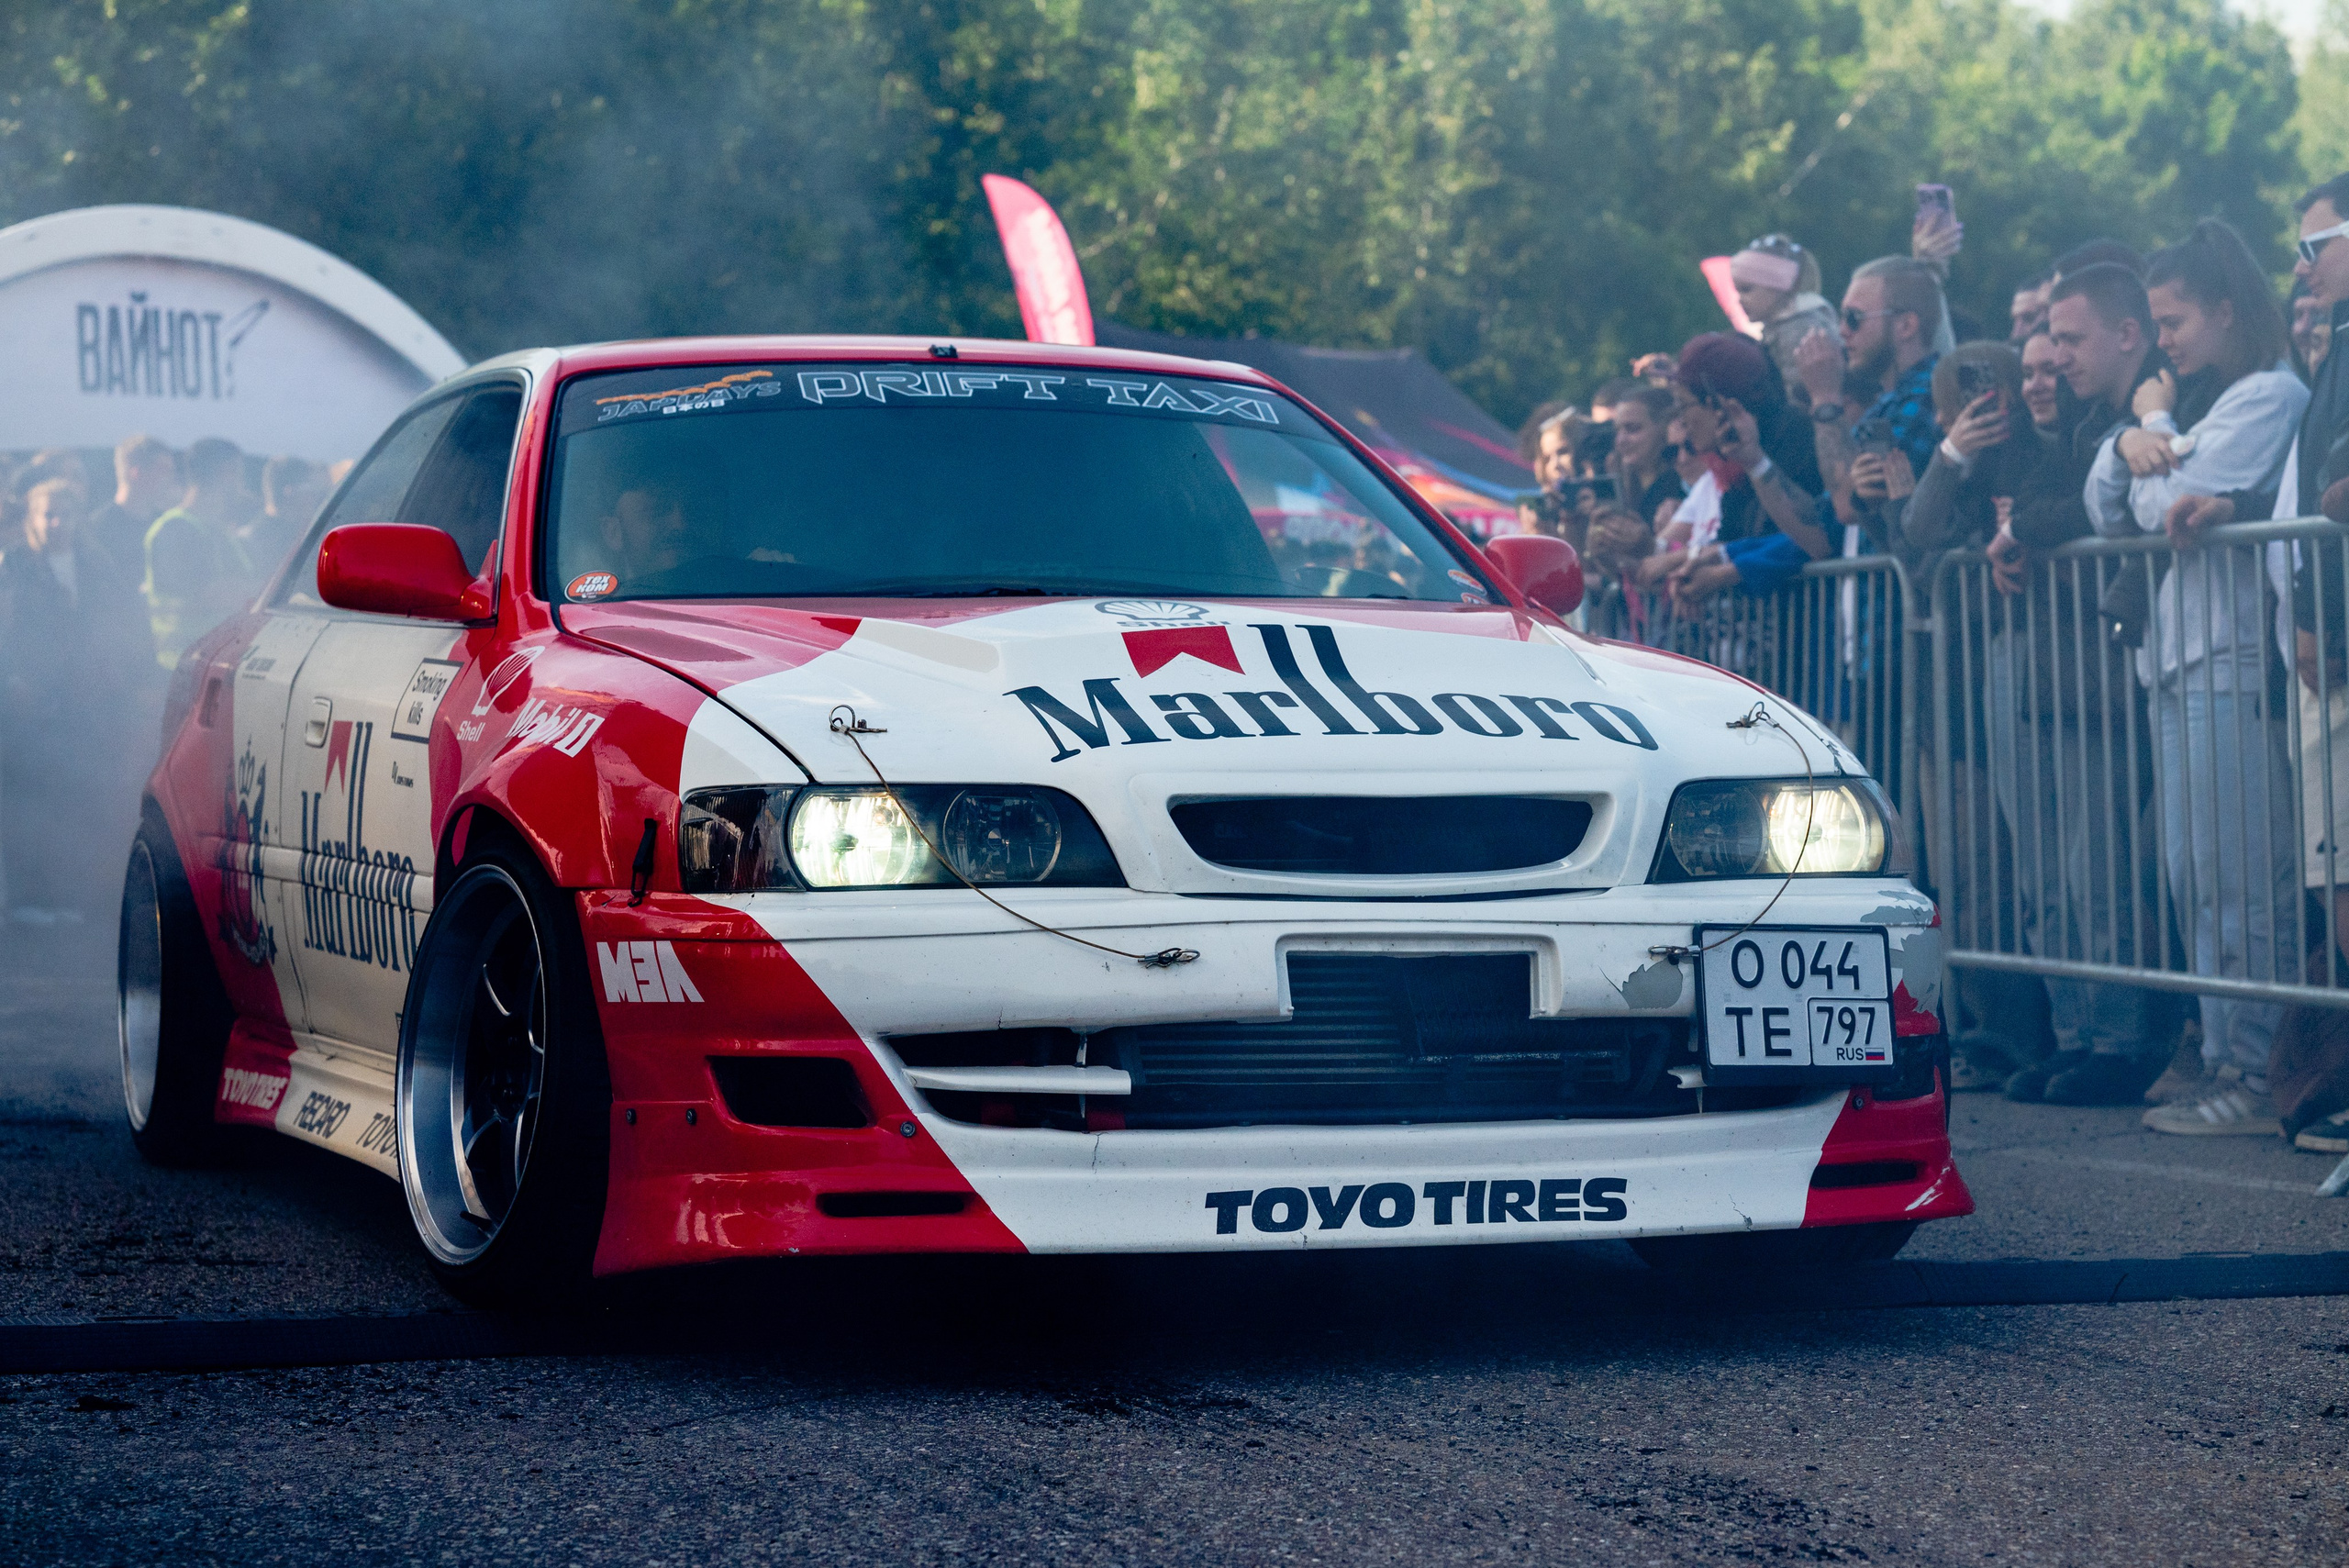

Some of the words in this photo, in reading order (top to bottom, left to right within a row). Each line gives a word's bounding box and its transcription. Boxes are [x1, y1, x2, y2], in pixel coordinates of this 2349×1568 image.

[796, 371, 1065, 405] DRIFT
[1086, 377, 1280, 425] TAXI
[412, 670, 448, 701] Smoking
[1002, 624, 1659, 762] Marlboro
[406, 701, 424, 726] kills
[456, 720, 485, 742] Shell
[505, 697, 583, 745] Mobil
[1780, 940, 1861, 990] 044
[1725, 1006, 1792, 1056] TE
[1816, 1006, 1876, 1044] 797
[1836, 1047, 1865, 1061] RUS
[293, 1090, 351, 1140] RECARO
[1204, 1182, 1416, 1235] TOYO
[1422, 1177, 1629, 1226] TIRES
